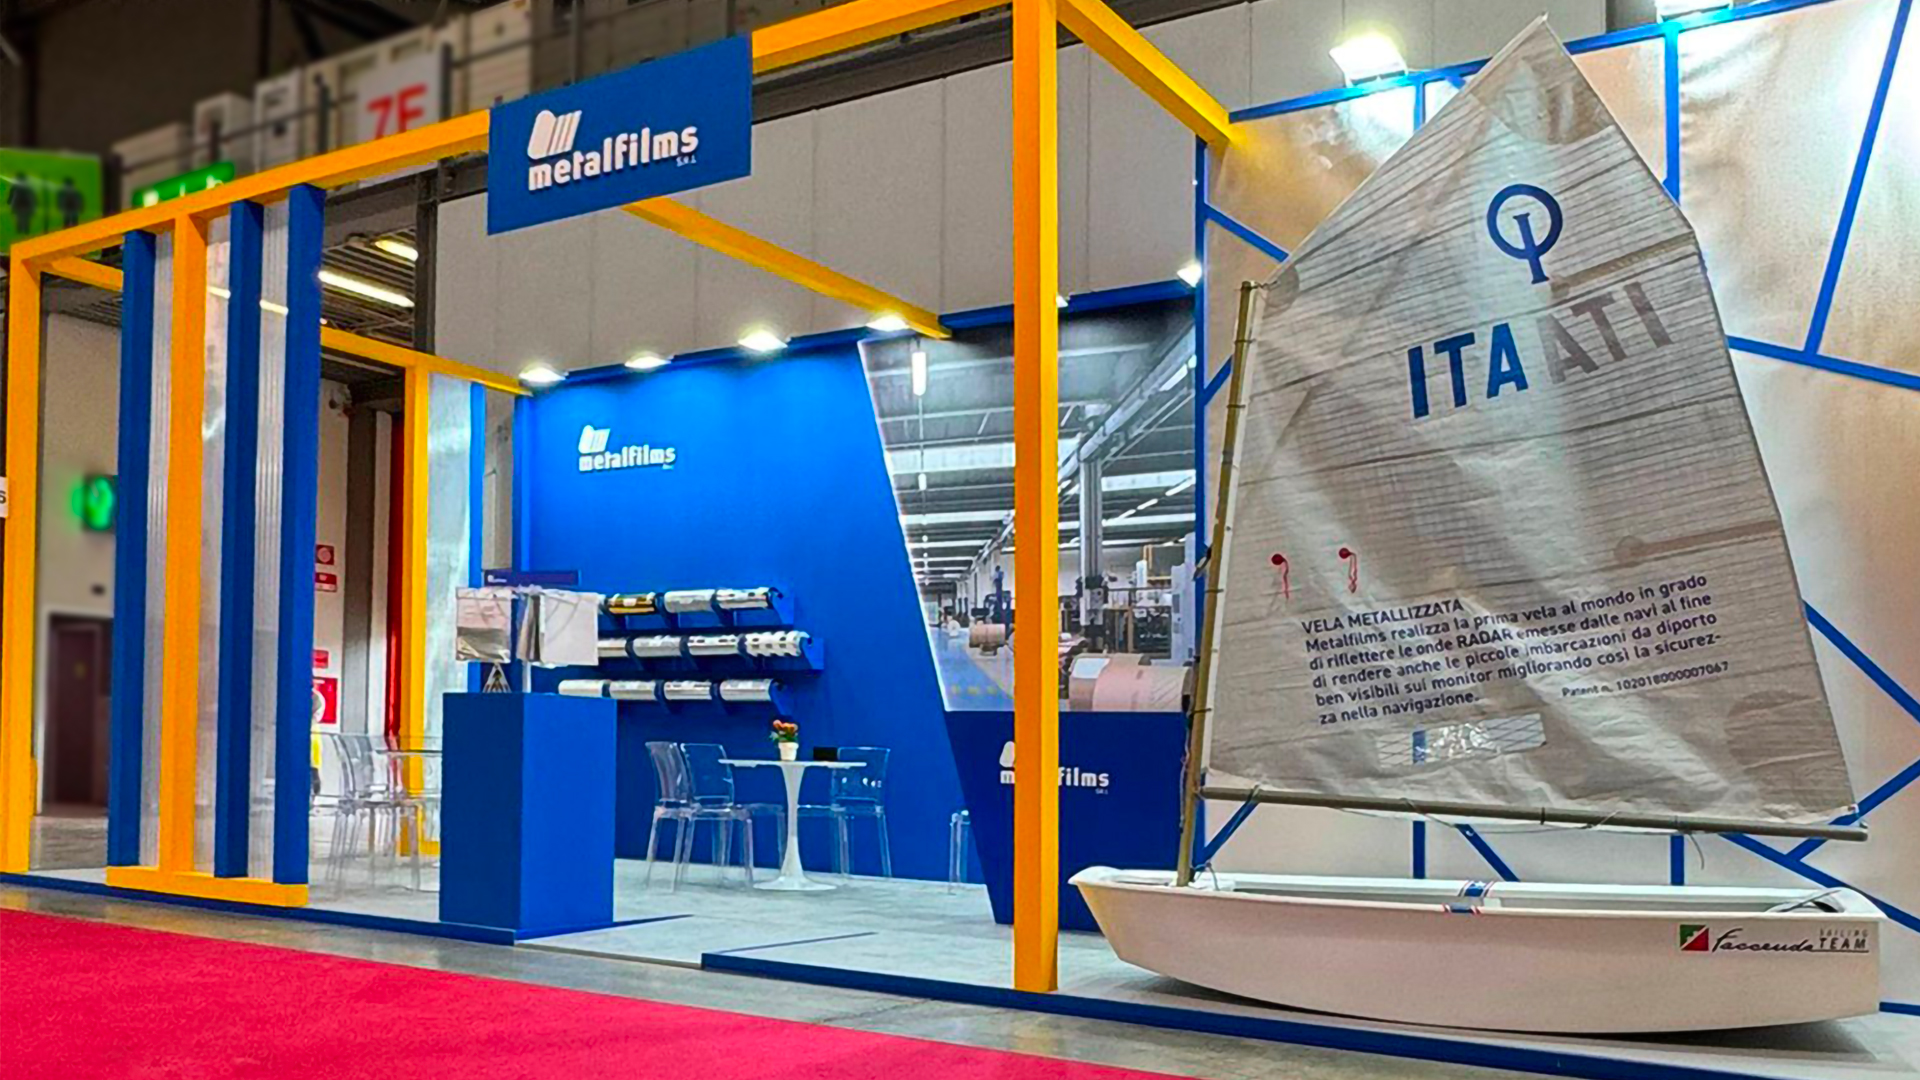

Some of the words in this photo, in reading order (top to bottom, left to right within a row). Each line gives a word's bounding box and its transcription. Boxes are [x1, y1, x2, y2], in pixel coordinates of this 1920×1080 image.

[528, 125, 699, 192] metalfilms
[1407, 322, 1529, 419] ITA
[579, 444, 676, 472] metalfilms
[1301, 616, 1345, 634] VELA
[1347, 598, 1464, 628] METALLIZZATA
[1306, 631, 1387, 653] Metalfilms
[1391, 621, 1450, 640] realizza
[1453, 617, 1470, 630] la
[1473, 612, 1518, 631] prima
[1521, 605, 1557, 621] vela
[1561, 600, 1577, 616] al
[1581, 590, 1635, 612] mondo
[1638, 585, 1655, 600] in
[1659, 575, 1707, 598] grado
[1309, 656, 1324, 671] di
[1327, 648, 1395, 669] riflettere
[1398, 644, 1413, 658] le
[1416, 638, 1453, 656] onde
[1456, 628, 1514, 649] RADAR
[1516, 622, 1576, 640] emesse
[1580, 613, 1620, 631] dalle
[1623, 602, 1658, 622] navi
[1661, 598, 1677, 615] al
[1679, 594, 1712, 611] fine
[1312, 674, 1327, 689] di
[1331, 667, 1392, 686] rendere
[1397, 659, 1442, 677] anche
[1444, 656, 1461, 670] le
[1465, 645, 1519, 669] piccole
[1525, 628, 1627, 657] imbarcazioni
[1631, 625, 1652, 640] da
[1656, 613, 1718, 636] diporto
[1315, 693, 1345, 707] ben
[1347, 681, 1400, 702] visibili
[1431, 670, 1493, 690] monitor
[1497, 656, 1593, 680] migliorando
[1633, 645, 1651, 659] la
[1654, 632, 1722, 655] sicurez-
[1319, 712, 1338, 725] za
[1341, 705, 1379, 722] nella
[1382, 692, 1481, 715] navigazione.
[1000, 766, 1109, 788] mfilms
[1819, 937, 1867, 950] TEAM
